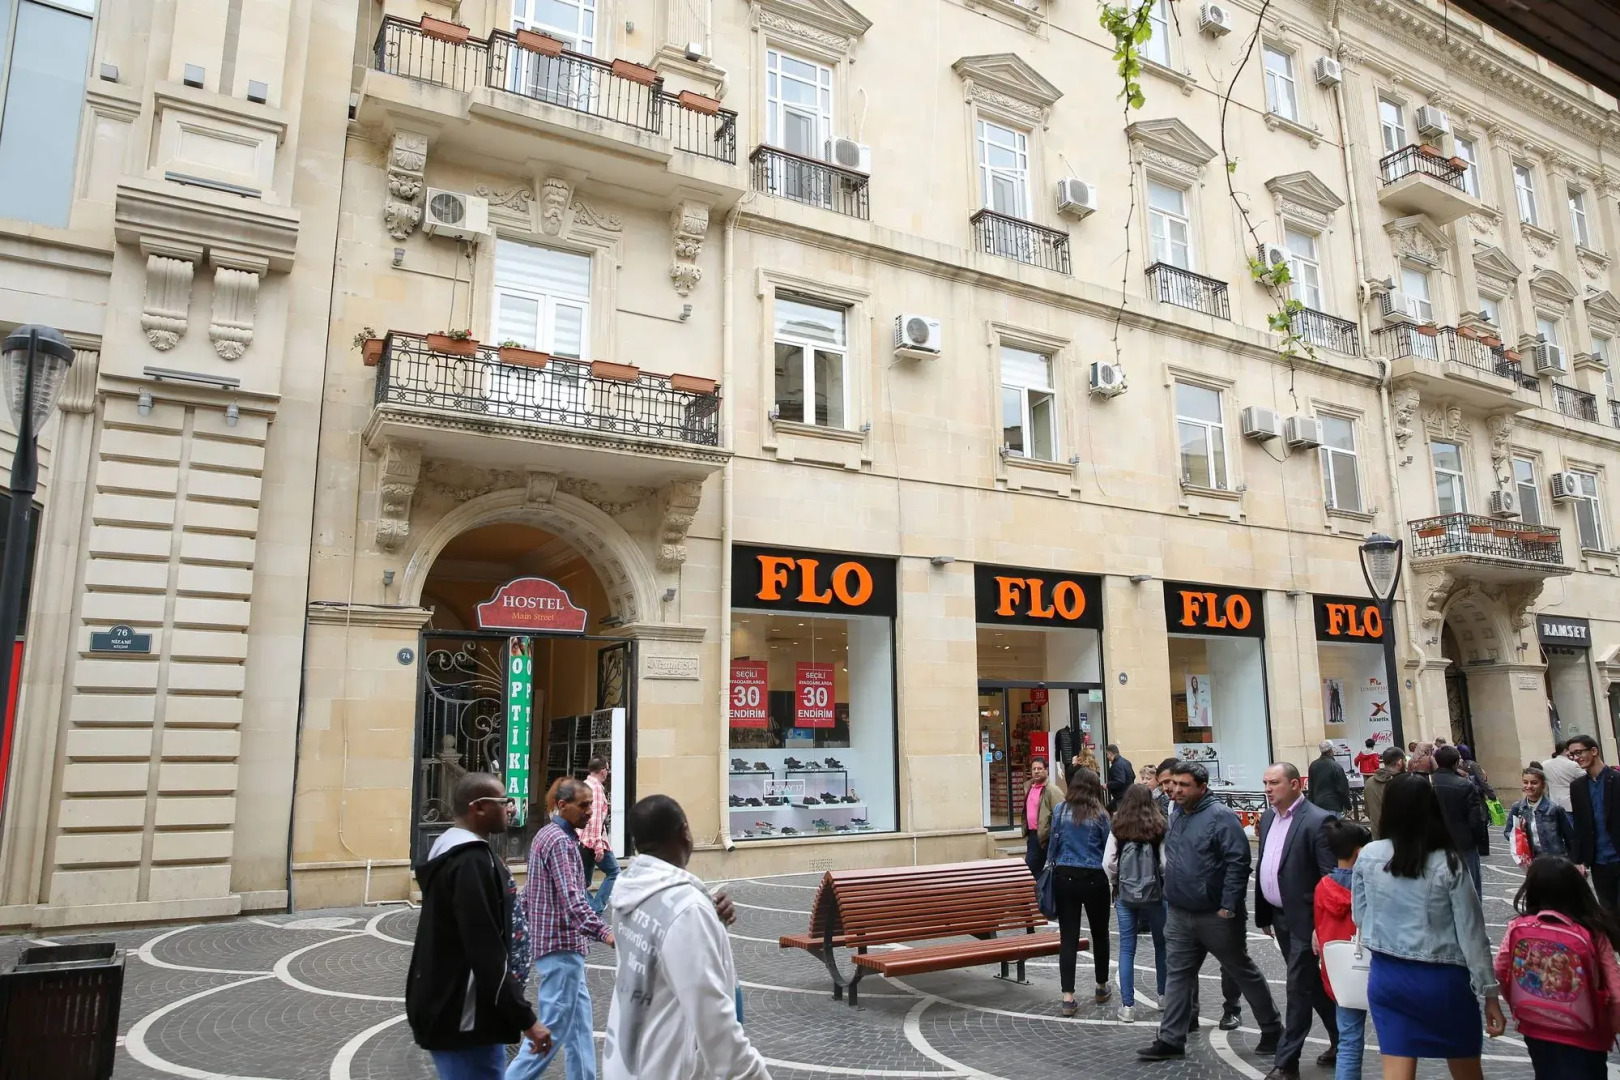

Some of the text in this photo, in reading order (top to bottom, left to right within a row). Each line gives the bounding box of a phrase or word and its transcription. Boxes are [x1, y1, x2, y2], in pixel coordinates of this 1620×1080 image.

[755, 554, 873, 606] FLO
[503, 595, 565, 610] HOSTEL
[994, 576, 1086, 620] FLO
[511, 612, 555, 621] Main Street
[1178, 591, 1252, 630] FLO
[1325, 603, 1383, 638] FLO
[116, 628, 128, 637] 76
[1543, 623, 1587, 639] RAMSEY
[735, 670, 758, 679] SEÇİLİ
[805, 672, 826, 680] SEÇİLİ
[798, 708, 833, 718] ENDİRİM
[508, 657, 523, 794] OPTİKA
